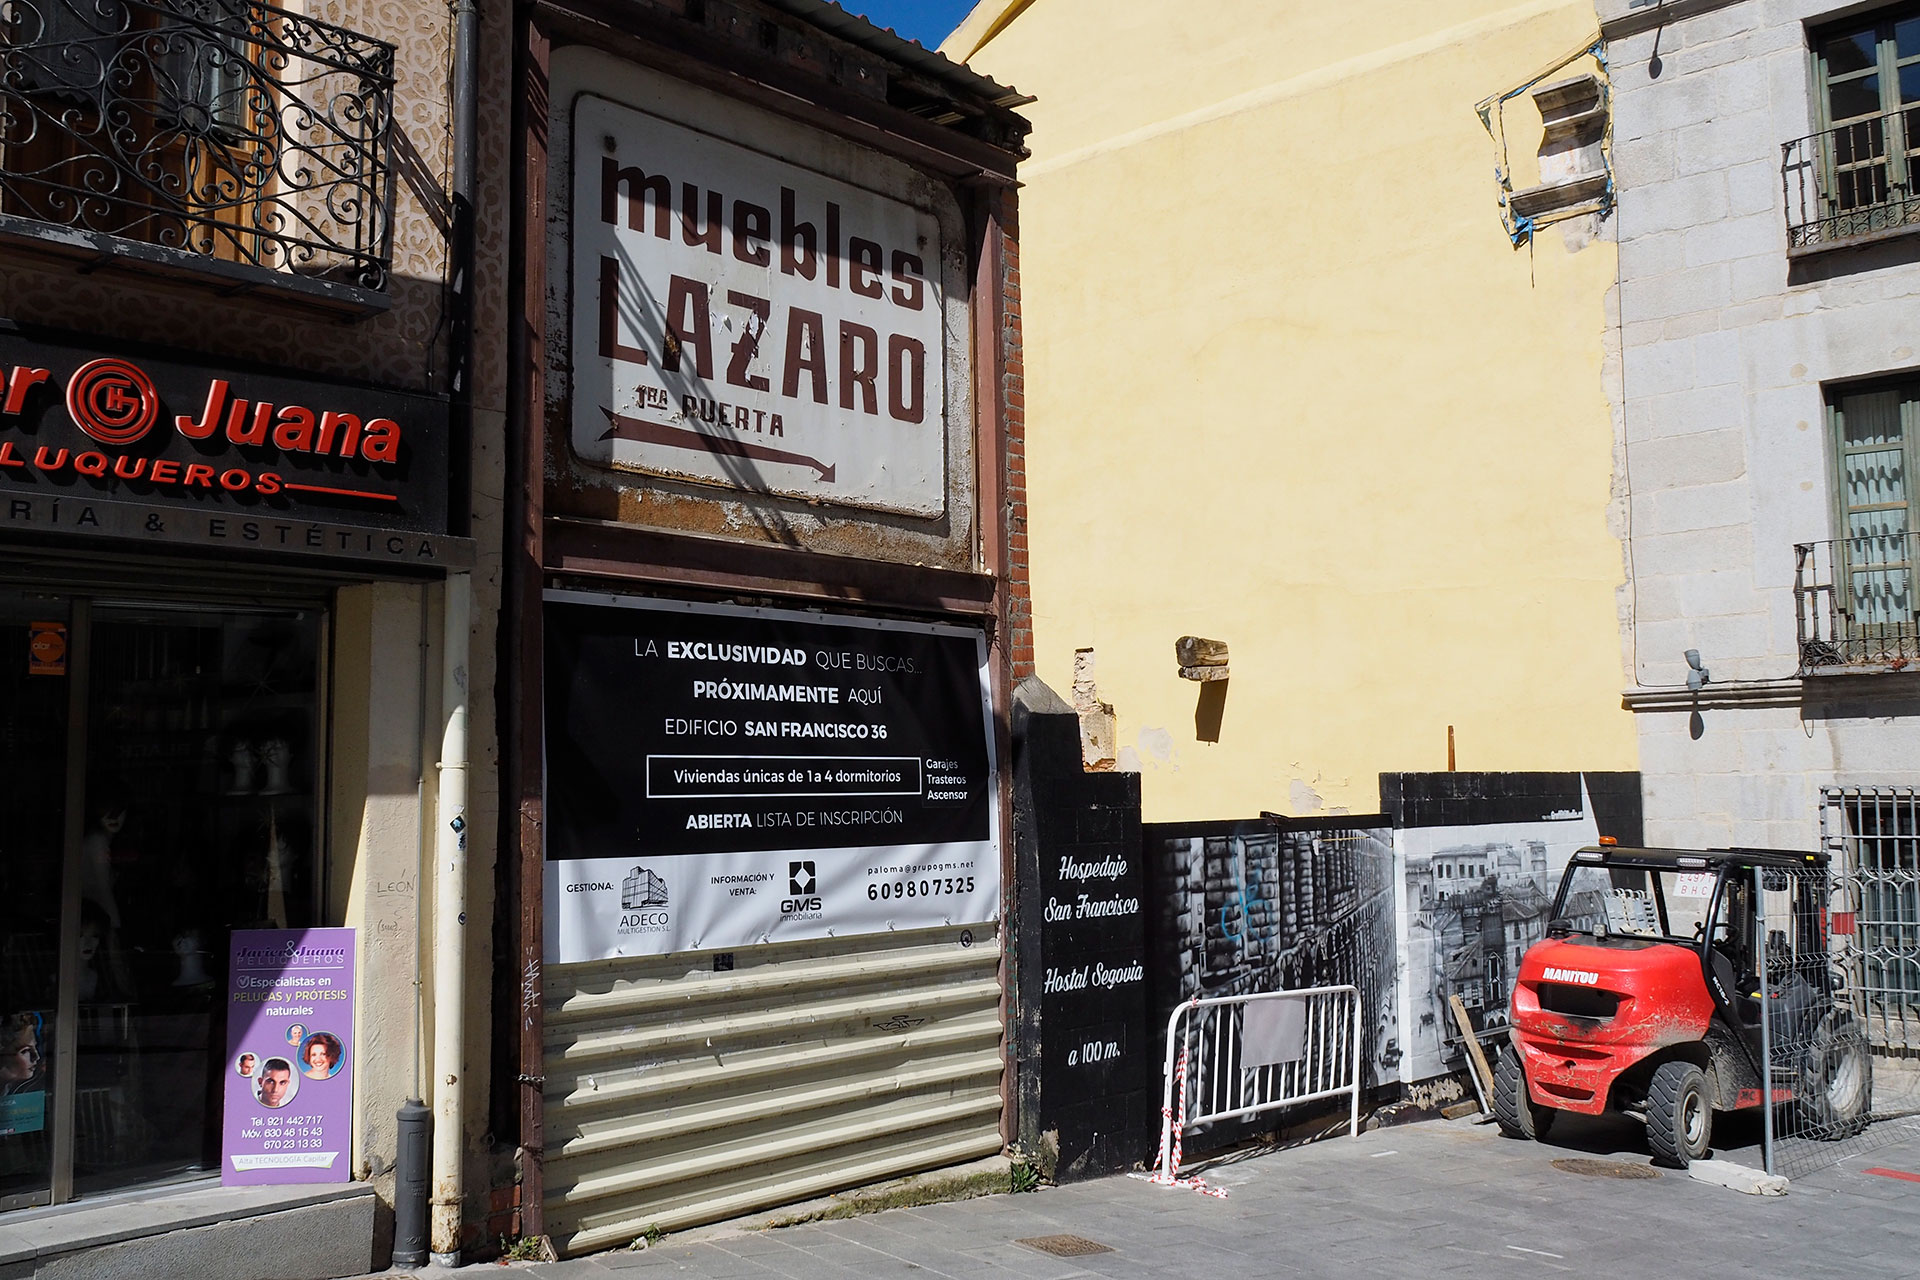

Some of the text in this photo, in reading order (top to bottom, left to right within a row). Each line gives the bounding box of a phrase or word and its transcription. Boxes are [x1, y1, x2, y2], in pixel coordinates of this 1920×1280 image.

[601, 155, 924, 312] muebles
[598, 254, 925, 425] LAZARO
[0, 365, 51, 417] r
[174, 379, 403, 464] Juana
[682, 393, 784, 437] PUERTA
[10, 498, 435, 559] RÍA & ESTÉTICA
[635, 638, 659, 658] LA
[667, 640, 807, 666] EXCLUSIVIDAD
[815, 650, 851, 671] QUE
[693, 678, 882, 706] PRÓXIMAMENTE AQUÍ
[665, 719, 888, 740] EDIFICIO SAN FRANCISCO 36
[926, 758, 959, 772] Garajes
[673, 769, 741, 785] Viviendas
[744, 767, 785, 784] únicas
[787, 769, 804, 784] de
[824, 769, 834, 783] 4
[835, 768, 901, 783] dormitorios
[926, 774, 967, 785] Trasteros
[927, 789, 969, 801] Ascensor
[686, 806, 903, 831] ABIERTA LISTA DE INSCRIPCIÓN
[867, 861, 975, 876] paloma@grupogms.net
[1058, 854, 1128, 885] Hospedaje
[377, 868, 417, 894] LEÓN
[711, 872, 776, 885] INFORMACIÓN Y
[566, 881, 615, 894] GESTIONA:
[729, 887, 758, 897] VENTA:
[867, 876, 975, 902] 609807325
[780, 897, 822, 914] GMS
[1044, 892, 1140, 923] San Francisco
[619, 912, 669, 928] ADECO
[779, 911, 822, 923] inmobiliaria
[284, 941, 299, 959] &
[297, 945, 345, 957] Juana
[236, 955, 345, 966] PELUQUEROS
[250, 976, 332, 989] Especialistas en
[1044, 959, 1144, 994] Hostal Segovia
[1541, 967, 1598, 985] MANITOU
[234, 988, 348, 1004] PELUCAS y PRÓTESIS
[266, 1005, 314, 1017] naturales
[1068, 1040, 1121, 1066] a 100 m.
[251, 1115, 323, 1127] Tel. 921 442 717
[264, 1128, 282, 1138] 630
[311, 1126, 323, 1137] 43
[264, 1138, 323, 1150] 670 23 13 33
[255, 1156, 302, 1165] TECNOLOGÍA
